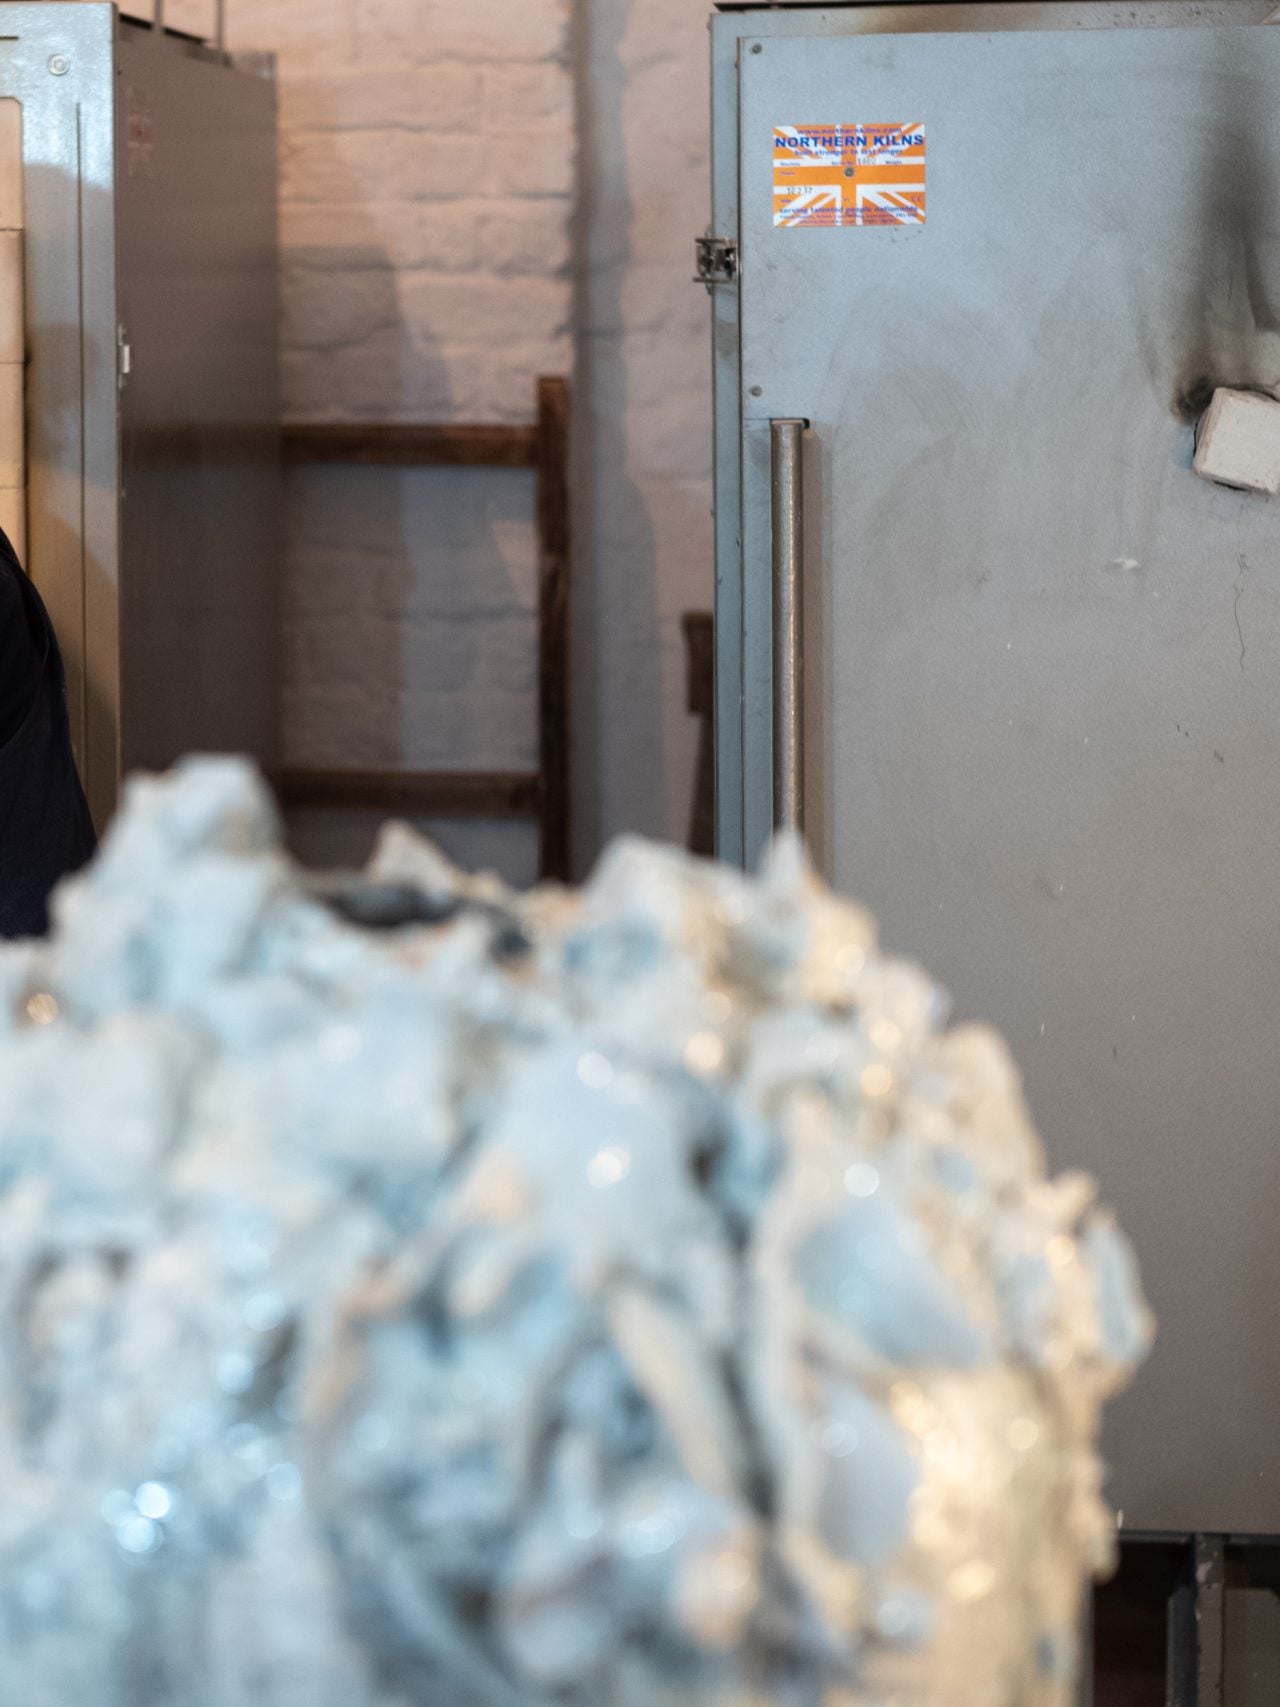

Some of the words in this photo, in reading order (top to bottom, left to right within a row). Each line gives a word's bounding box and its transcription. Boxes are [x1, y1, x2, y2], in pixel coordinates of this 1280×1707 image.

[775, 135, 867, 148] NORTHERN
[873, 134, 924, 146] KILNS
[815, 148, 847, 157] stronger
[878, 147, 903, 156] longer
